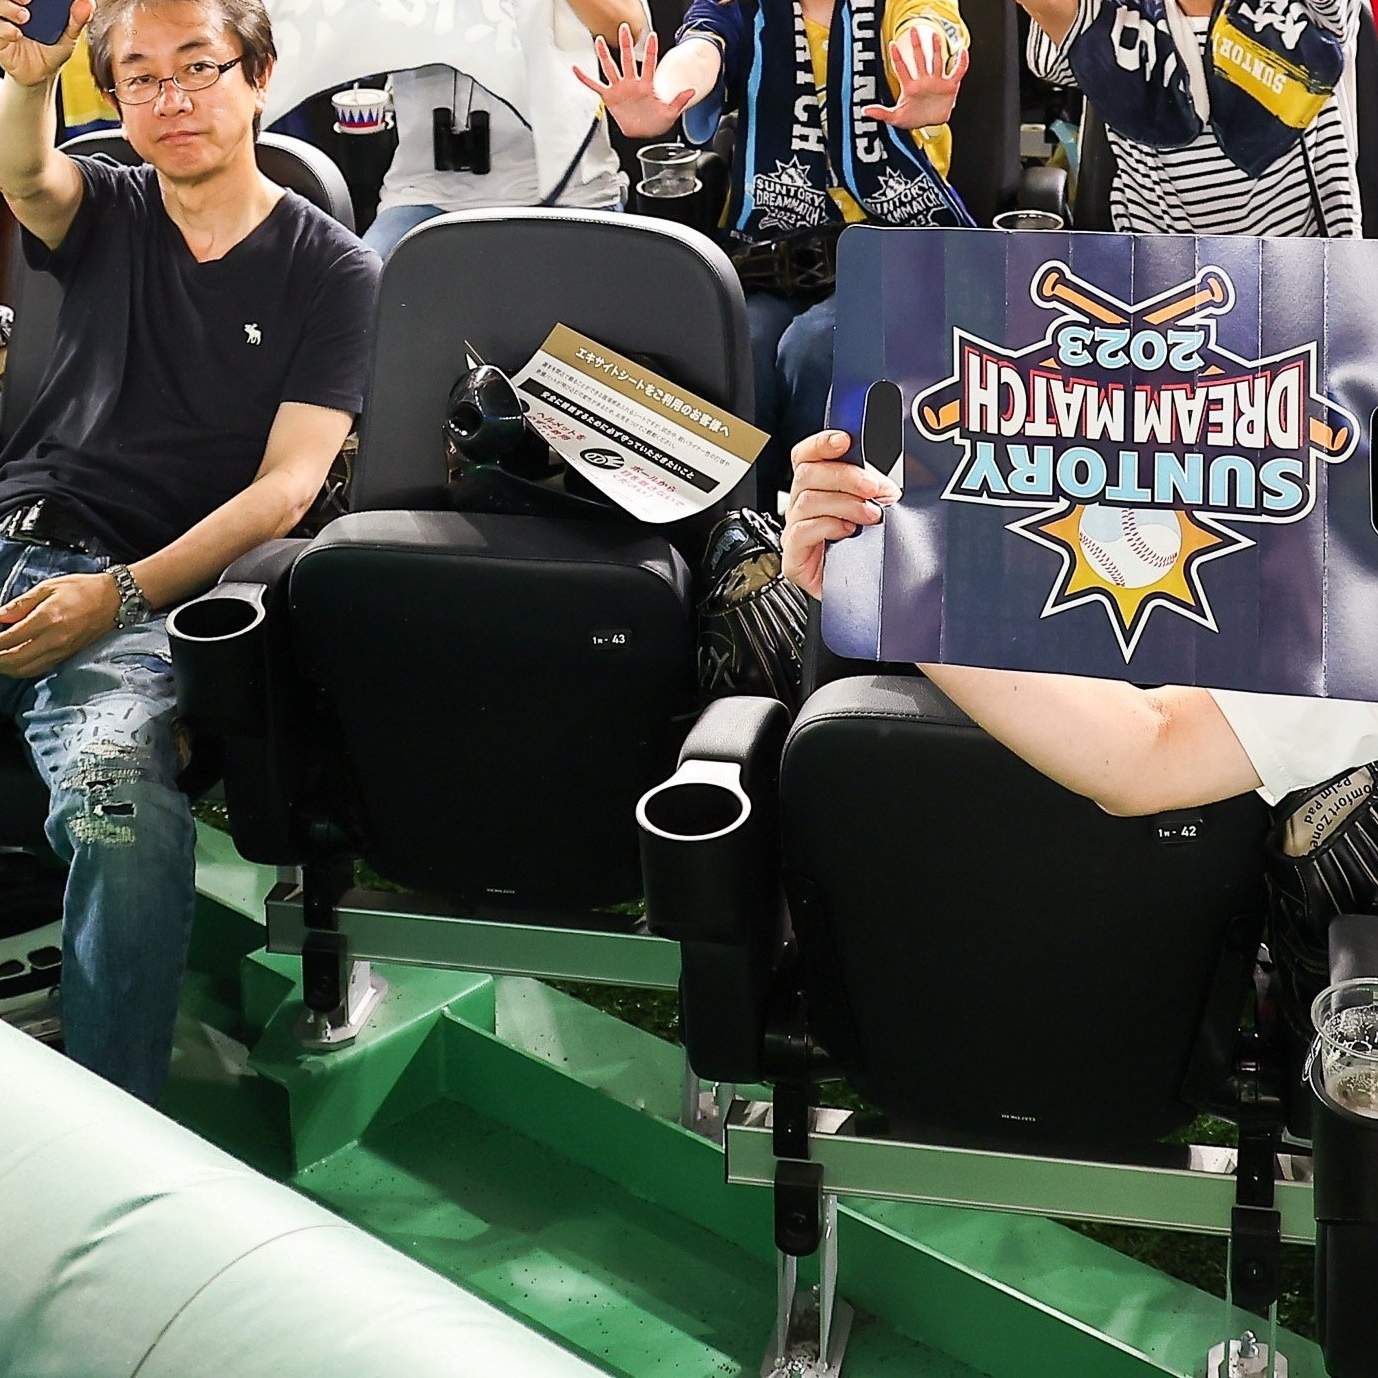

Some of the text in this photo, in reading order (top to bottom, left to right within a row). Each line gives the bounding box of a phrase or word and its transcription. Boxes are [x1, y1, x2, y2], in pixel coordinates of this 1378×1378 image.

[756, 179, 823, 207] SUNTORY
[871, 178, 929, 214] UNTORY
[1057, 325, 1205, 370] 2023
[575, 347, 731, 438] エキサイトシートをご利用のお客様へ
[963, 345, 1306, 449] DREAM MATCH
[536, 412, 587, 441] ヘルメットを
[631, 464, 677, 492] ボールから
[962, 439, 1306, 513] SUNTORY
[611, 633, 626, 644] 43
[1303, 800, 1323, 824] Pad
[1309, 784, 1372, 848] omfort Zone
[1180, 825, 1197, 838] 42
